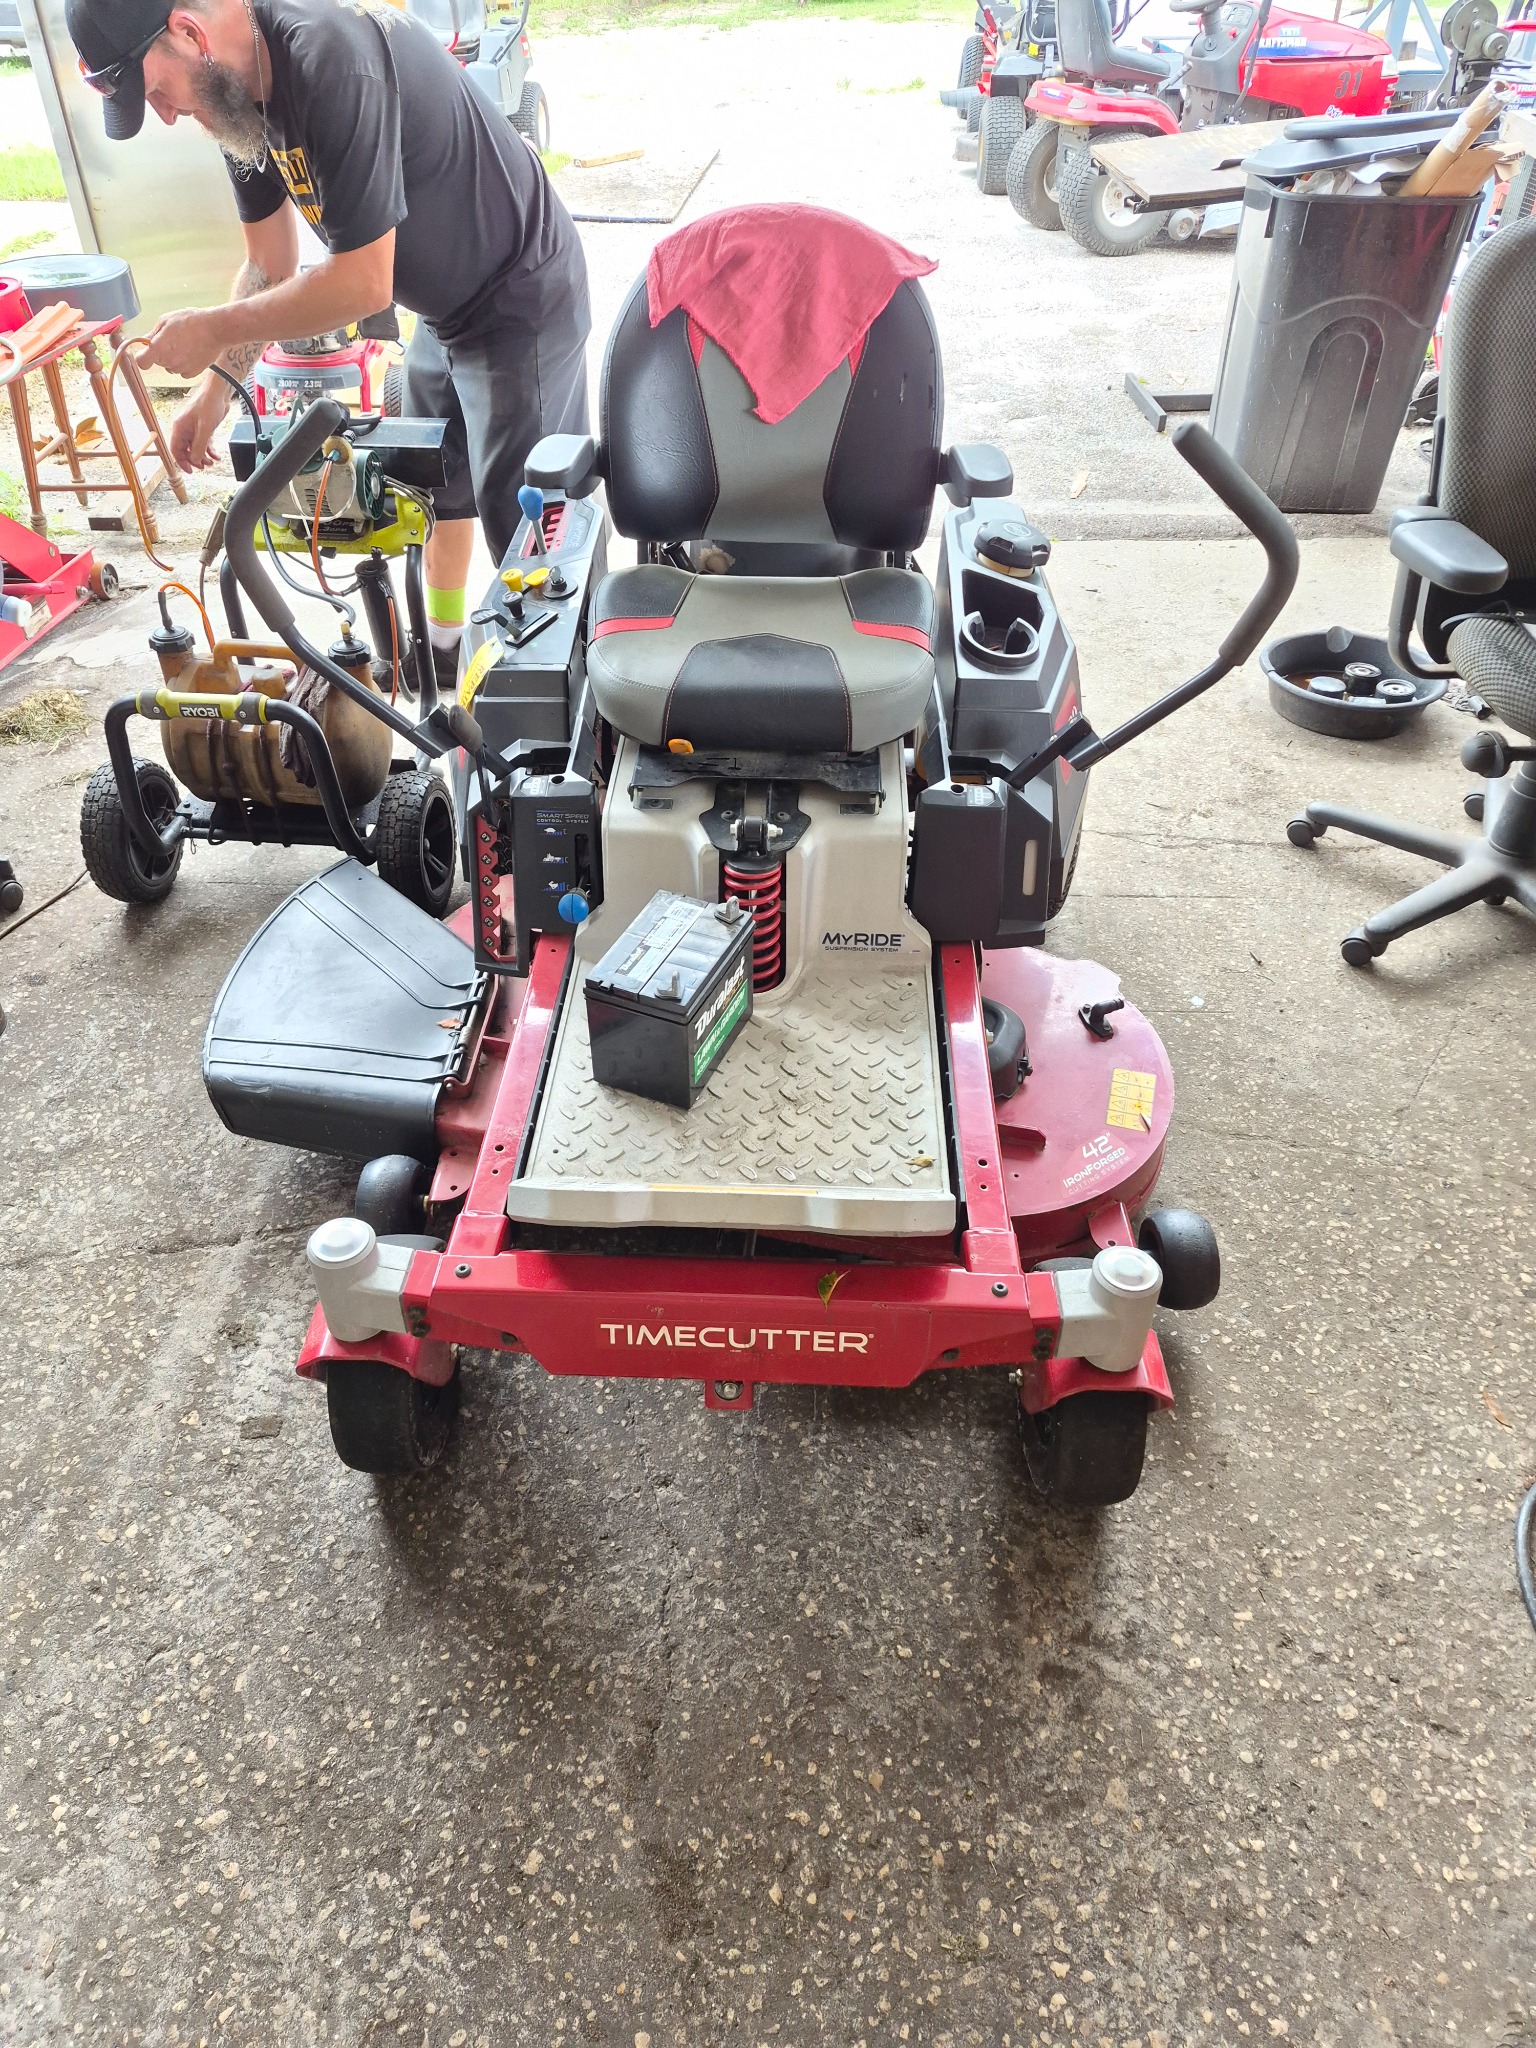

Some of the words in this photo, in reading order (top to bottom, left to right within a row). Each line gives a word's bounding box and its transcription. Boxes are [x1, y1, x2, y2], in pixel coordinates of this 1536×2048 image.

[1257, 37, 1307, 48] RAFTSMAN
[1334, 69, 1363, 98] 31
[181, 707, 220, 717] RYOBI
[695, 955, 746, 1040] Duralast
[1062, 1147, 1126, 1188] IRONFORGED
[1068, 1173, 1100, 1195] CUTTING
[1102, 1156, 1130, 1176] SYSTEM
[600, 1323, 870, 1354] TIMECUTTER
